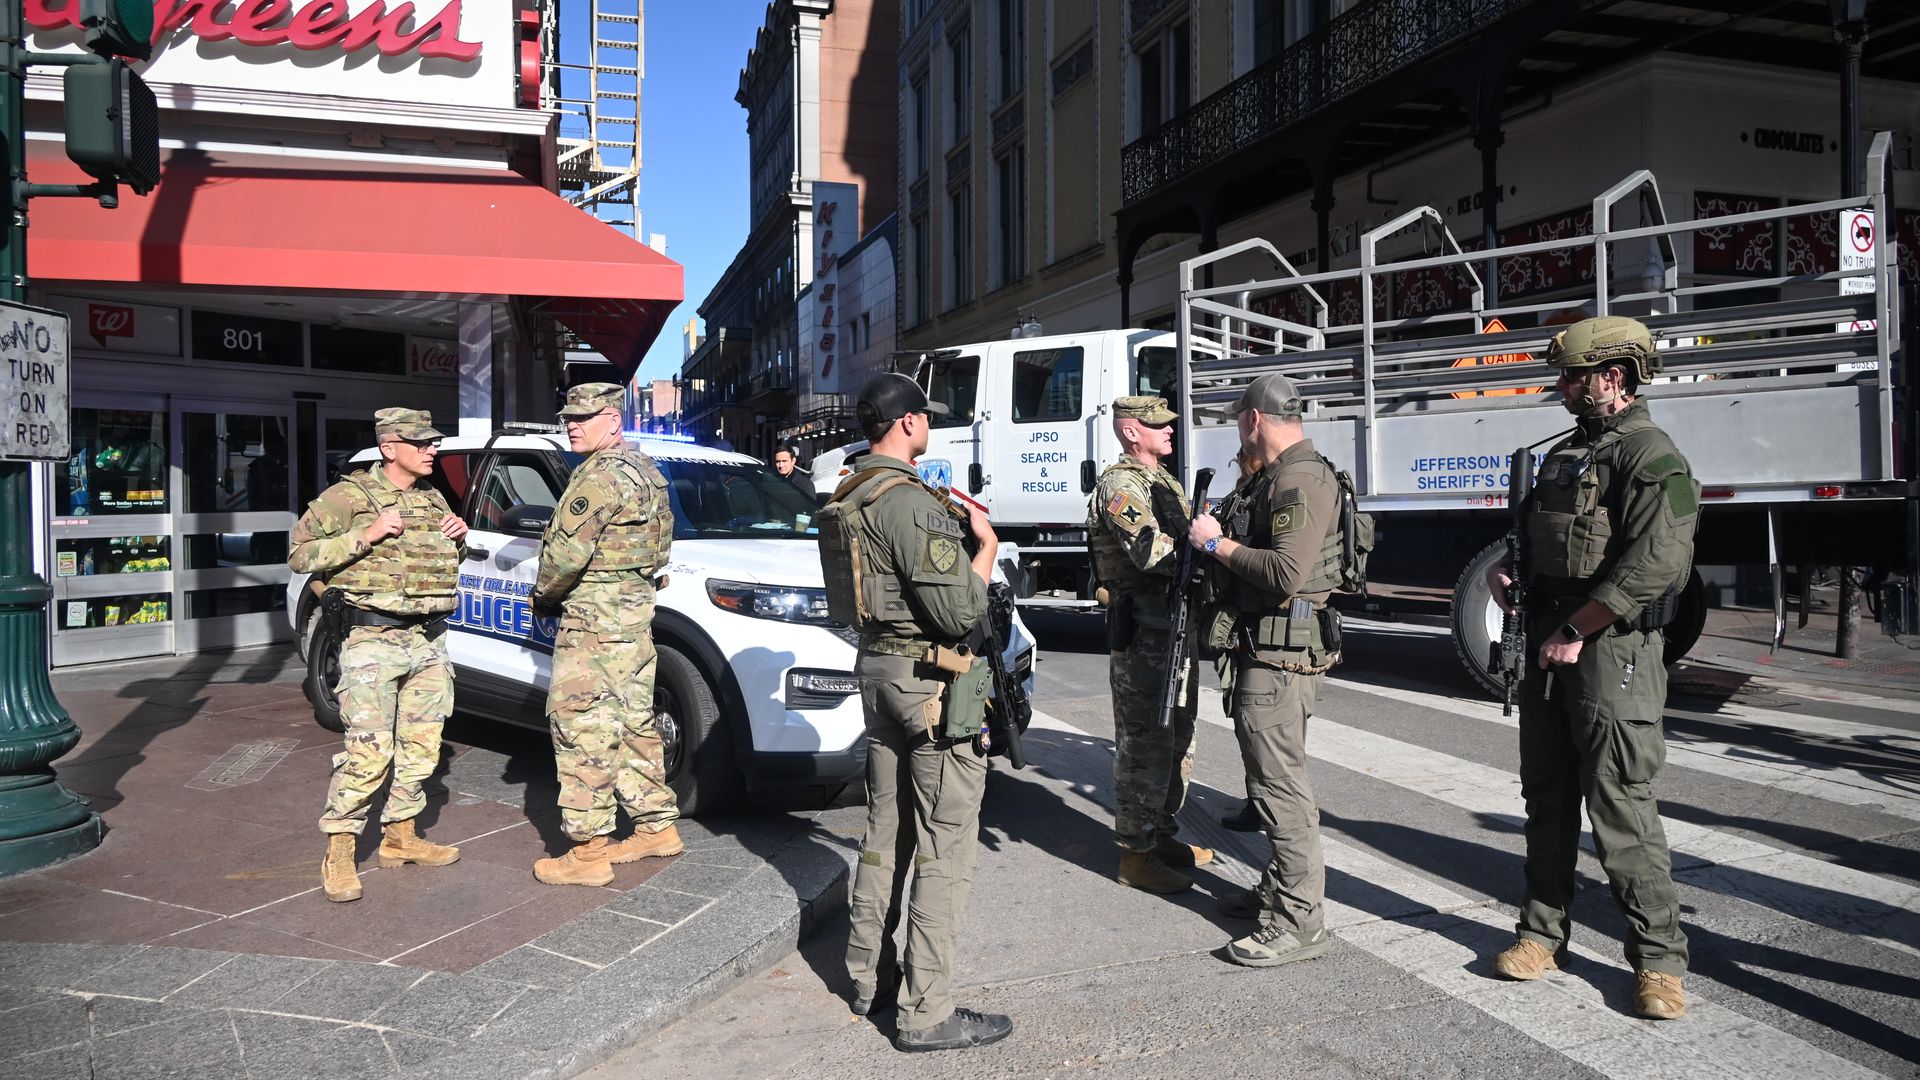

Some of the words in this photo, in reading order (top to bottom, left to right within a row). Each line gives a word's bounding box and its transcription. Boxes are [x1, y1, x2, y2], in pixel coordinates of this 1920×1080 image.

[1754, 128, 1824, 154] CHOCOLATES
[1843, 255, 1853, 267] NO
[1855, 256, 1875, 269] TRUC
[816, 202, 838, 378] Krystal
[13, 319, 51, 353] NO
[223, 328, 262, 351] 801
[8, 358, 55, 385] TURN
[20, 391, 46, 414] ON
[16, 422, 50, 446] RED
[1029, 431, 1059, 443] JPSO
[1021, 452, 1067, 464] SEARCH
[1411, 456, 1499, 473] JEFFERSON
[1040, 467, 1048, 478] &
[1418, 473, 1495, 490] SHERIFF'S
[1022, 481, 1068, 493] RESCUE
[930, 514, 959, 535] D15
[459, 574, 483, 590] NEW
[483, 577, 534, 597] ORLEANS
